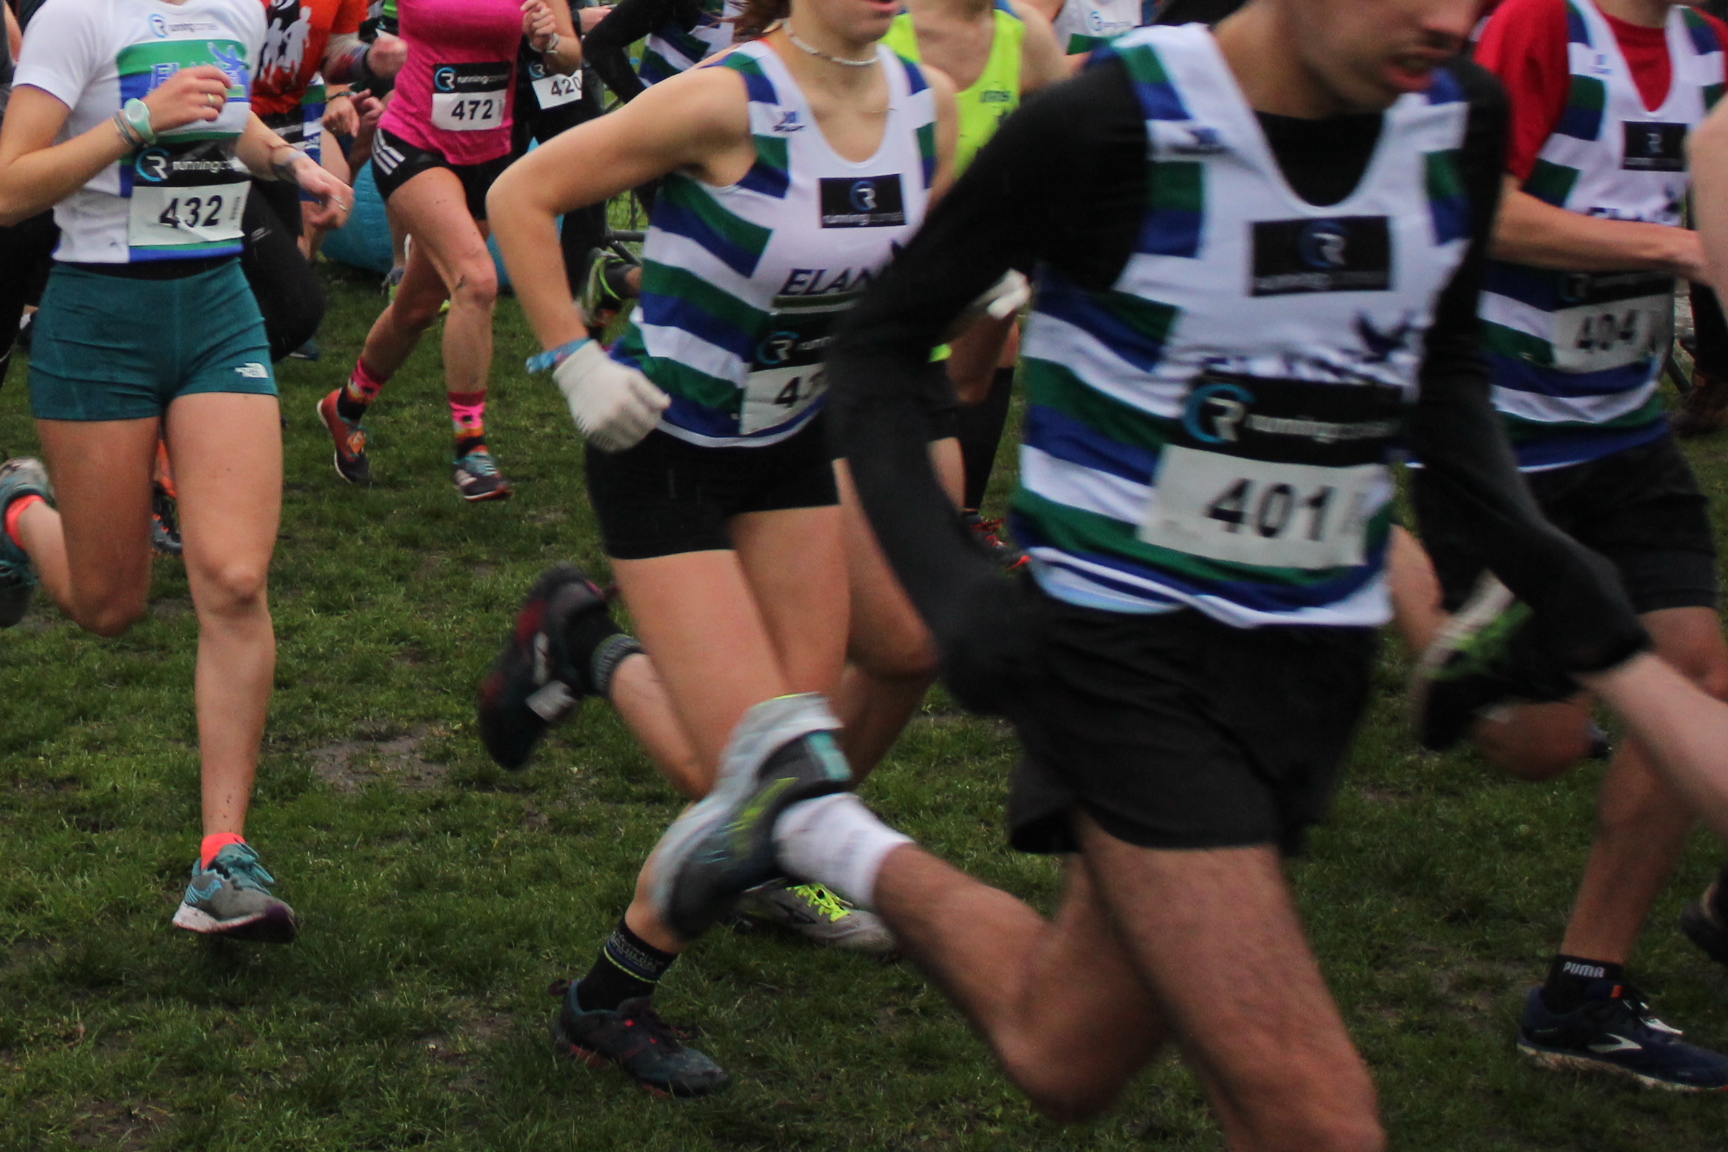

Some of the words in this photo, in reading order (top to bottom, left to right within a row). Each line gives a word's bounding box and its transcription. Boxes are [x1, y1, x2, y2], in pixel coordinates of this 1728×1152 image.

[452, 99, 494, 120] 472
[159, 195, 223, 229] 432
[1208, 478, 1336, 542] 401
[1563, 961, 1606, 978] PUMA
